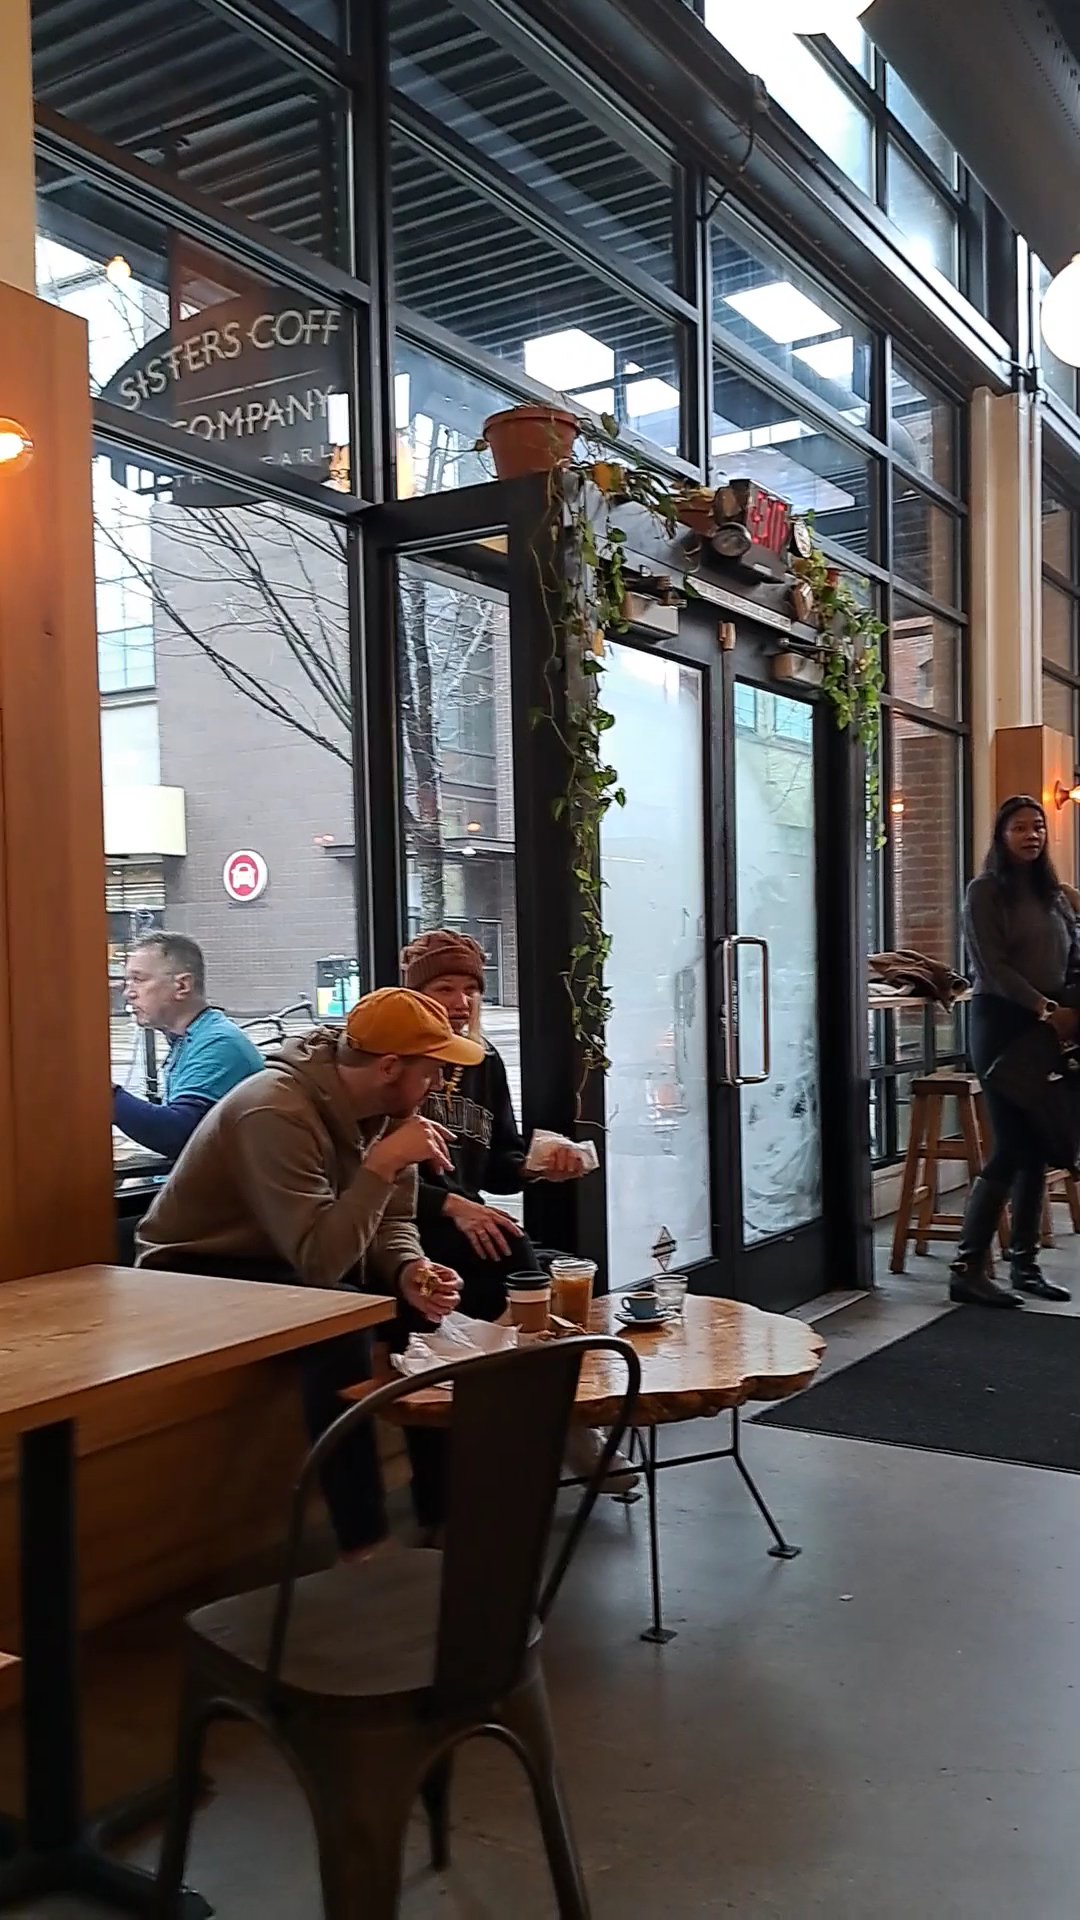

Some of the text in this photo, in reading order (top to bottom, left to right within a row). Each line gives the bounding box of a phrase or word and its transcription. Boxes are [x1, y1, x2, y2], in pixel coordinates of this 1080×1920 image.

[119, 309, 342, 411] SISTERS COFF
[172, 385, 336, 441] OMPANY
